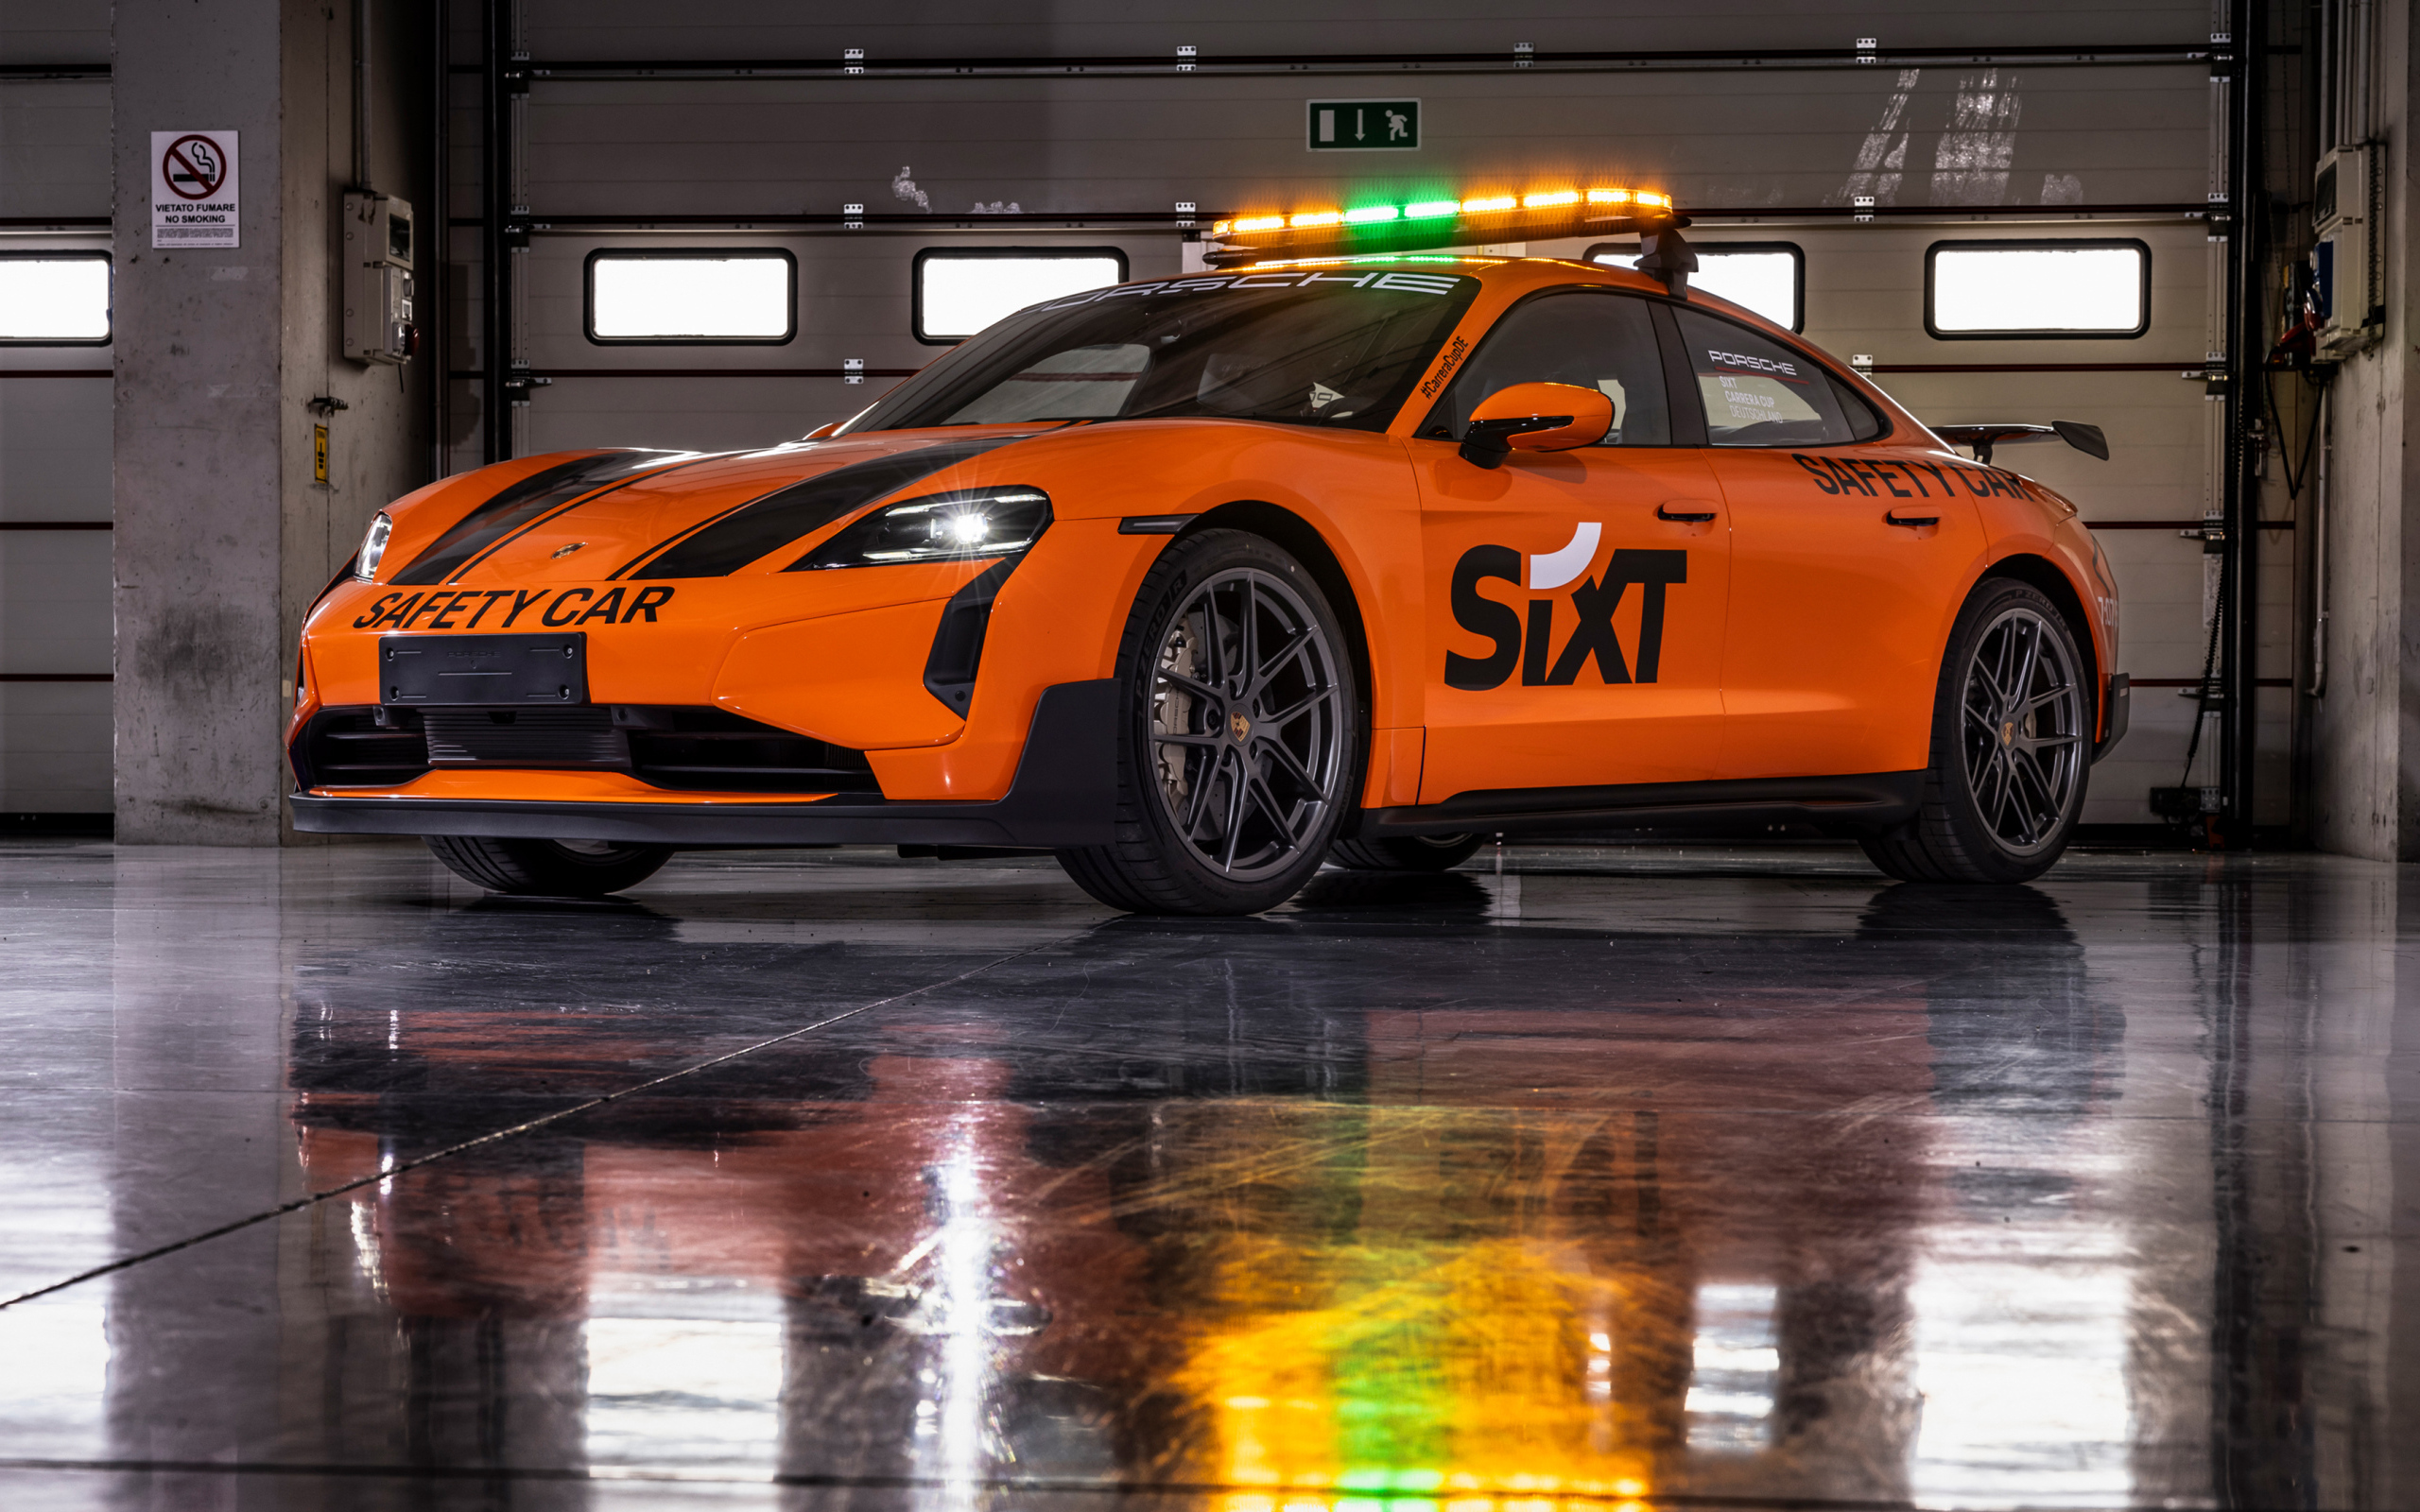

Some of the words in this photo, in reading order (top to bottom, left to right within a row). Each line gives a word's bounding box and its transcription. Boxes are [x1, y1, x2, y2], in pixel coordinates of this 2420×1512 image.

[155, 203, 194, 213] VIETATO
[196, 203, 236, 212] FUMARE
[182, 215, 226, 223] SMOKING
[1420, 335, 1469, 400] #CarreraCupDE
[1707, 350, 1798, 376] PORSCHE
[1719, 375, 1738, 389] SIXT
[1724, 390, 1759, 406] CARRERA
[1758, 395, 1775, 408] CUP
[1729, 404, 1784, 424] DEUTSCHLAND
[1791, 453, 1957, 499] SAFETY
[1950, 462, 2035, 503] CAR
[353, 589, 555, 629] SAFETY
[541, 586, 676, 627] CAR
[1139, 607, 1167, 675] ZERO
